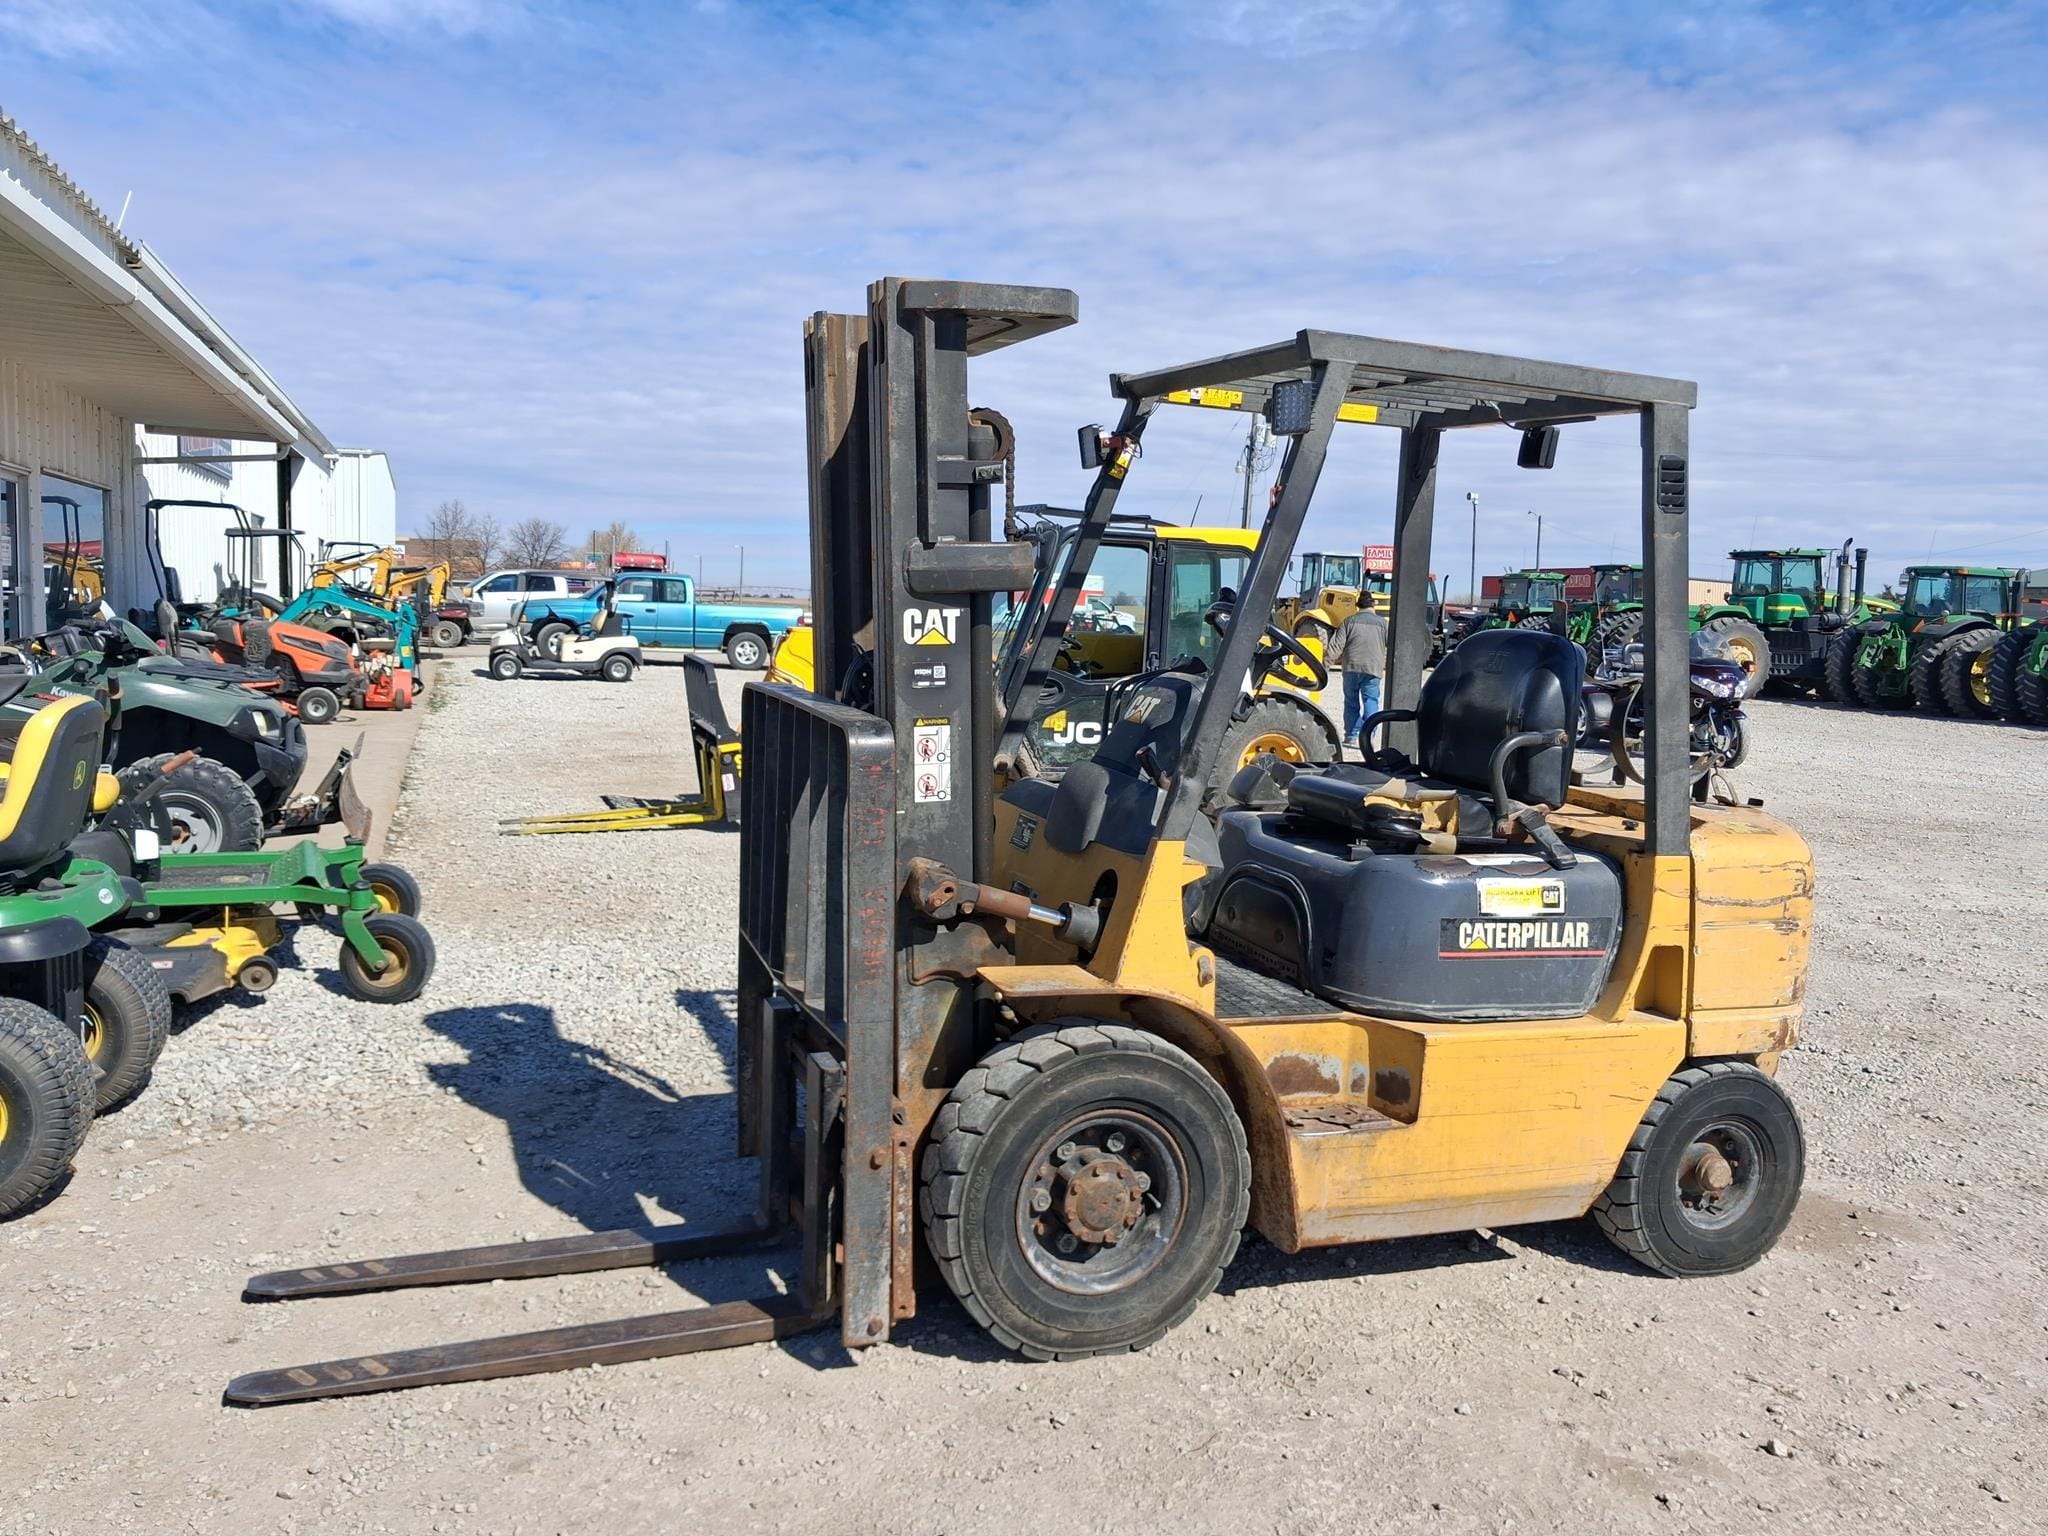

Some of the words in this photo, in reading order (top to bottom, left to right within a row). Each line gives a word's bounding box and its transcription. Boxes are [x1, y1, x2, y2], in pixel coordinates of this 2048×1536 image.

[1368, 548, 1393, 558] FAMIL
[903, 608, 960, 645] CAT
[1124, 695, 1161, 724] CAT
[1053, 722, 1113, 744] JC
[1543, 890, 1559, 904] CAT
[1459, 922, 1589, 948] CATERPILLAR
